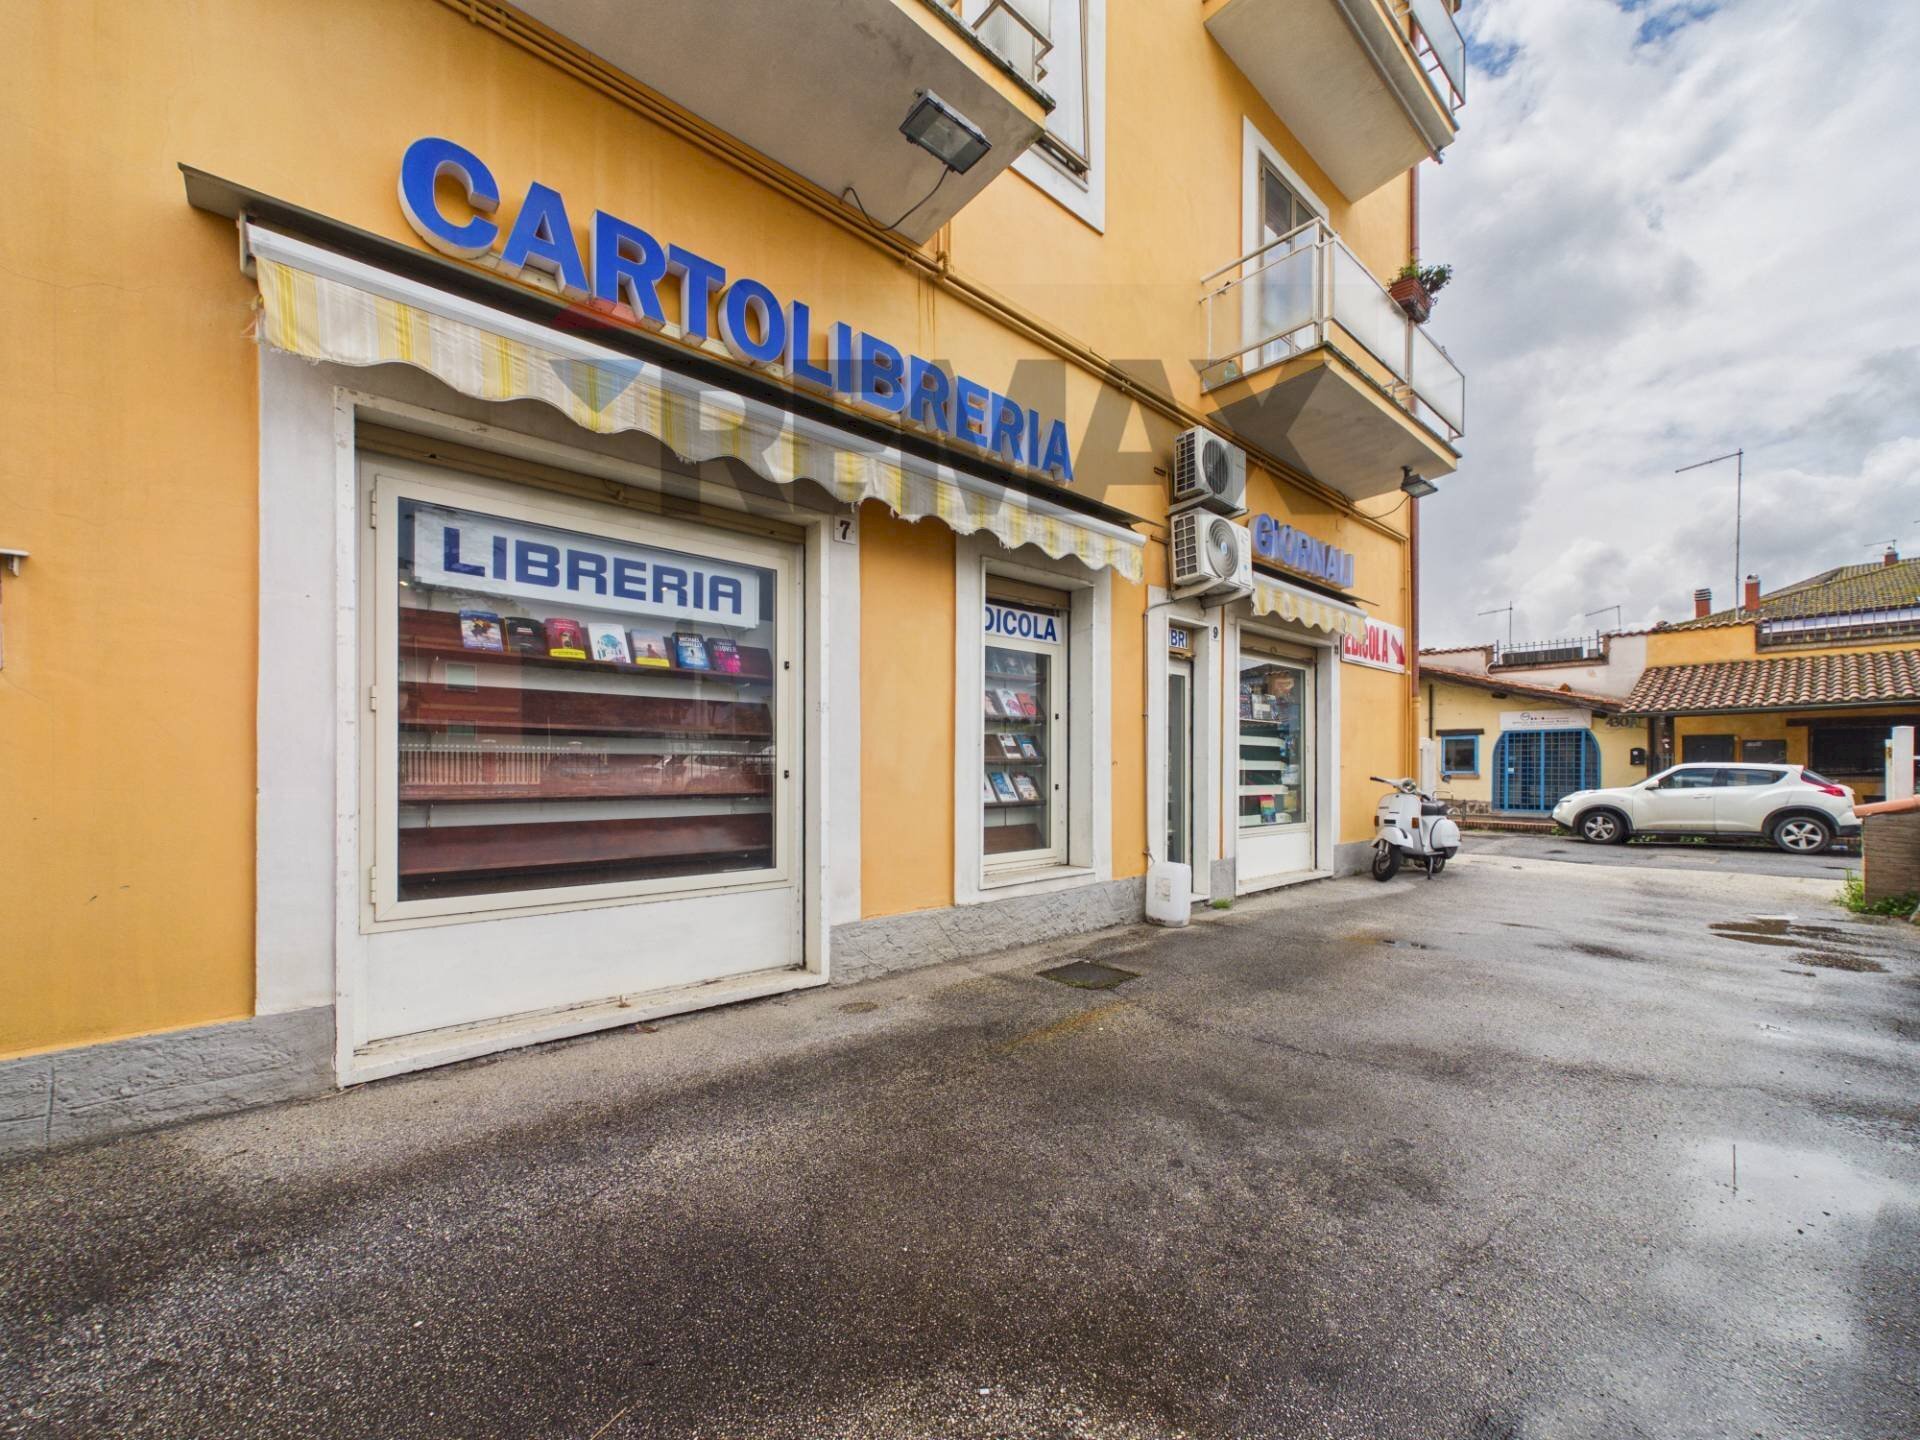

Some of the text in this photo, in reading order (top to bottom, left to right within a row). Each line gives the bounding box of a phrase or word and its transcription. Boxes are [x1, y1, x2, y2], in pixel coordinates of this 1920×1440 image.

[398, 137, 1074, 486] CARTOLIBRERIA
[840, 520, 851, 540] 7
[1250, 513, 1353, 588] GIORNALI
[443, 527, 742, 615] LIBRERIA
[1213, 626, 1219, 639] 9
